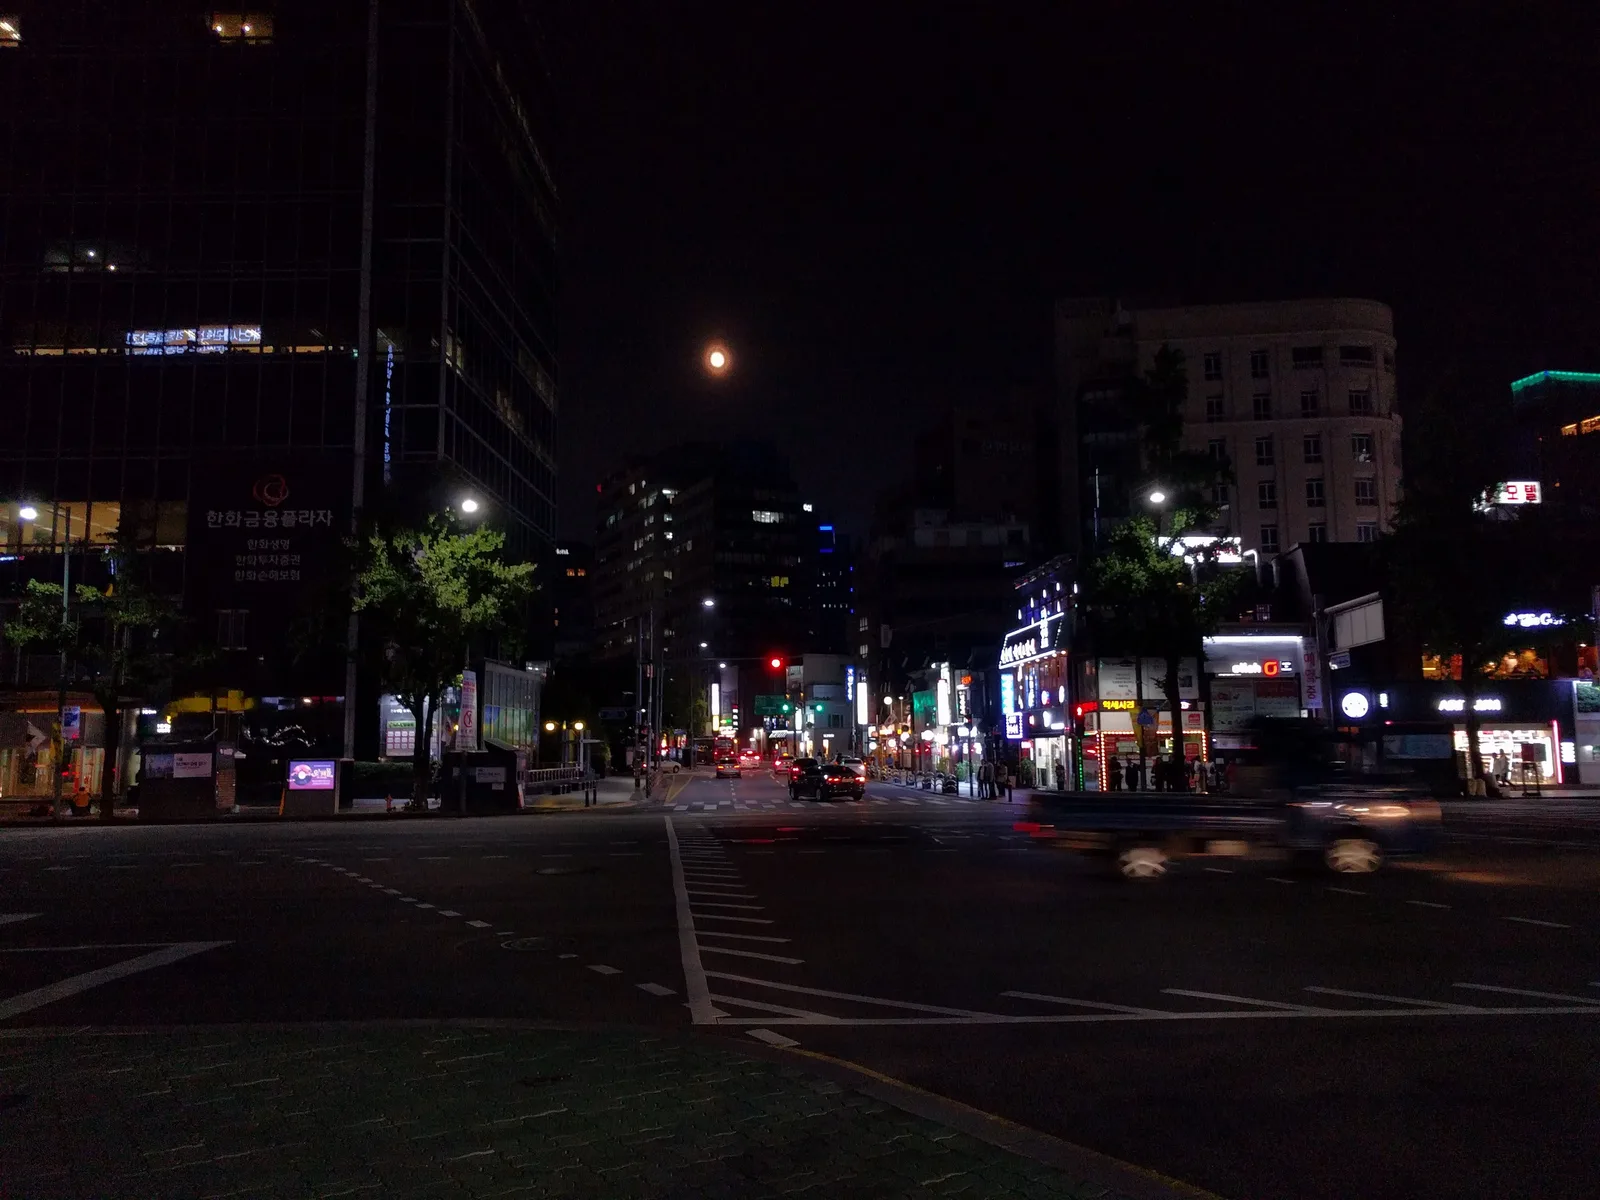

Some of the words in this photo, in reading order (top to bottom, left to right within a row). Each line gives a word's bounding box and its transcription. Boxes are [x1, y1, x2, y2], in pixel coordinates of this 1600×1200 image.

[206, 508, 333, 528] 한화금융플라자
[246, 538, 290, 551] 한화생명
[235, 554, 301, 567] 한화투자증권
[235, 569, 301, 582] 한화손해보험
